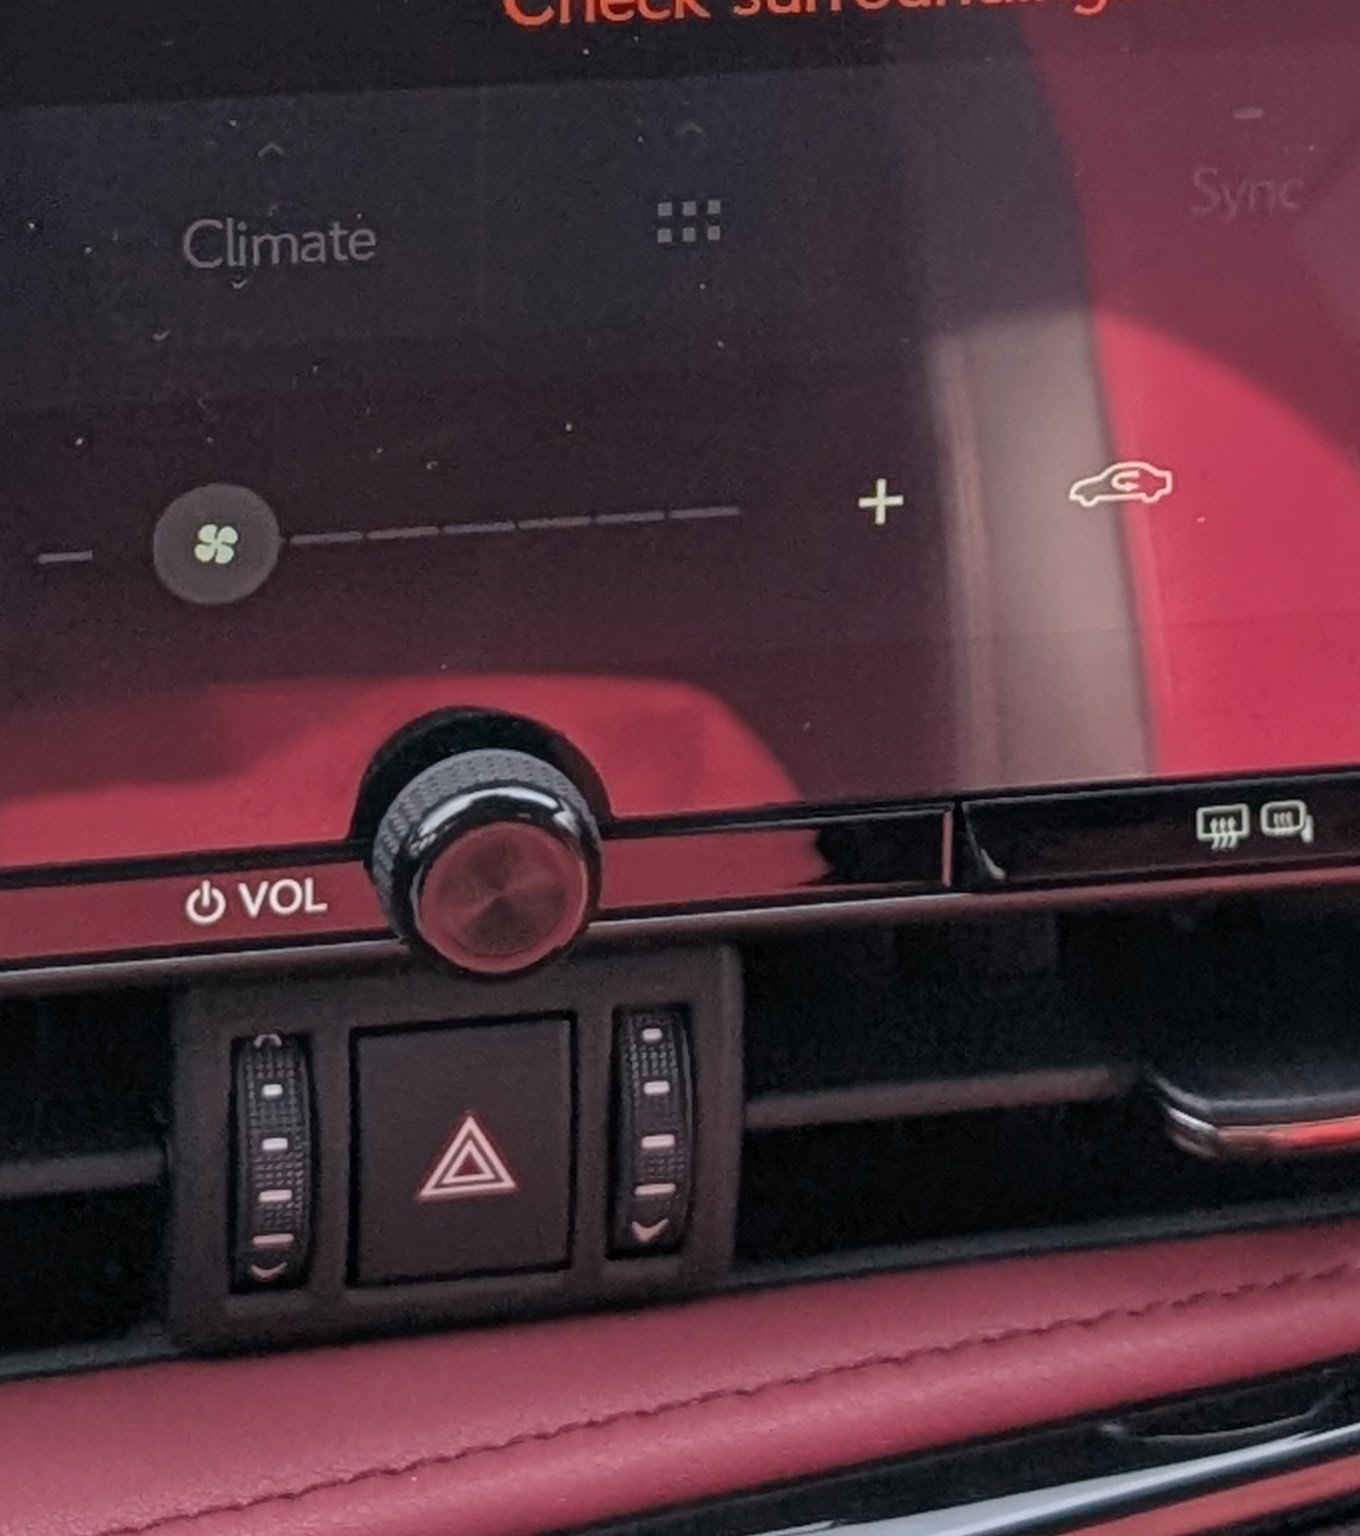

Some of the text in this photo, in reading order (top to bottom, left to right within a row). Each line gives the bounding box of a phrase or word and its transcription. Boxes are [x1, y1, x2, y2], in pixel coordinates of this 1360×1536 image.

[1190, 166, 1304, 224] Sync
[182, 217, 377, 268] Climate
[237, 876, 329, 918] VOL
